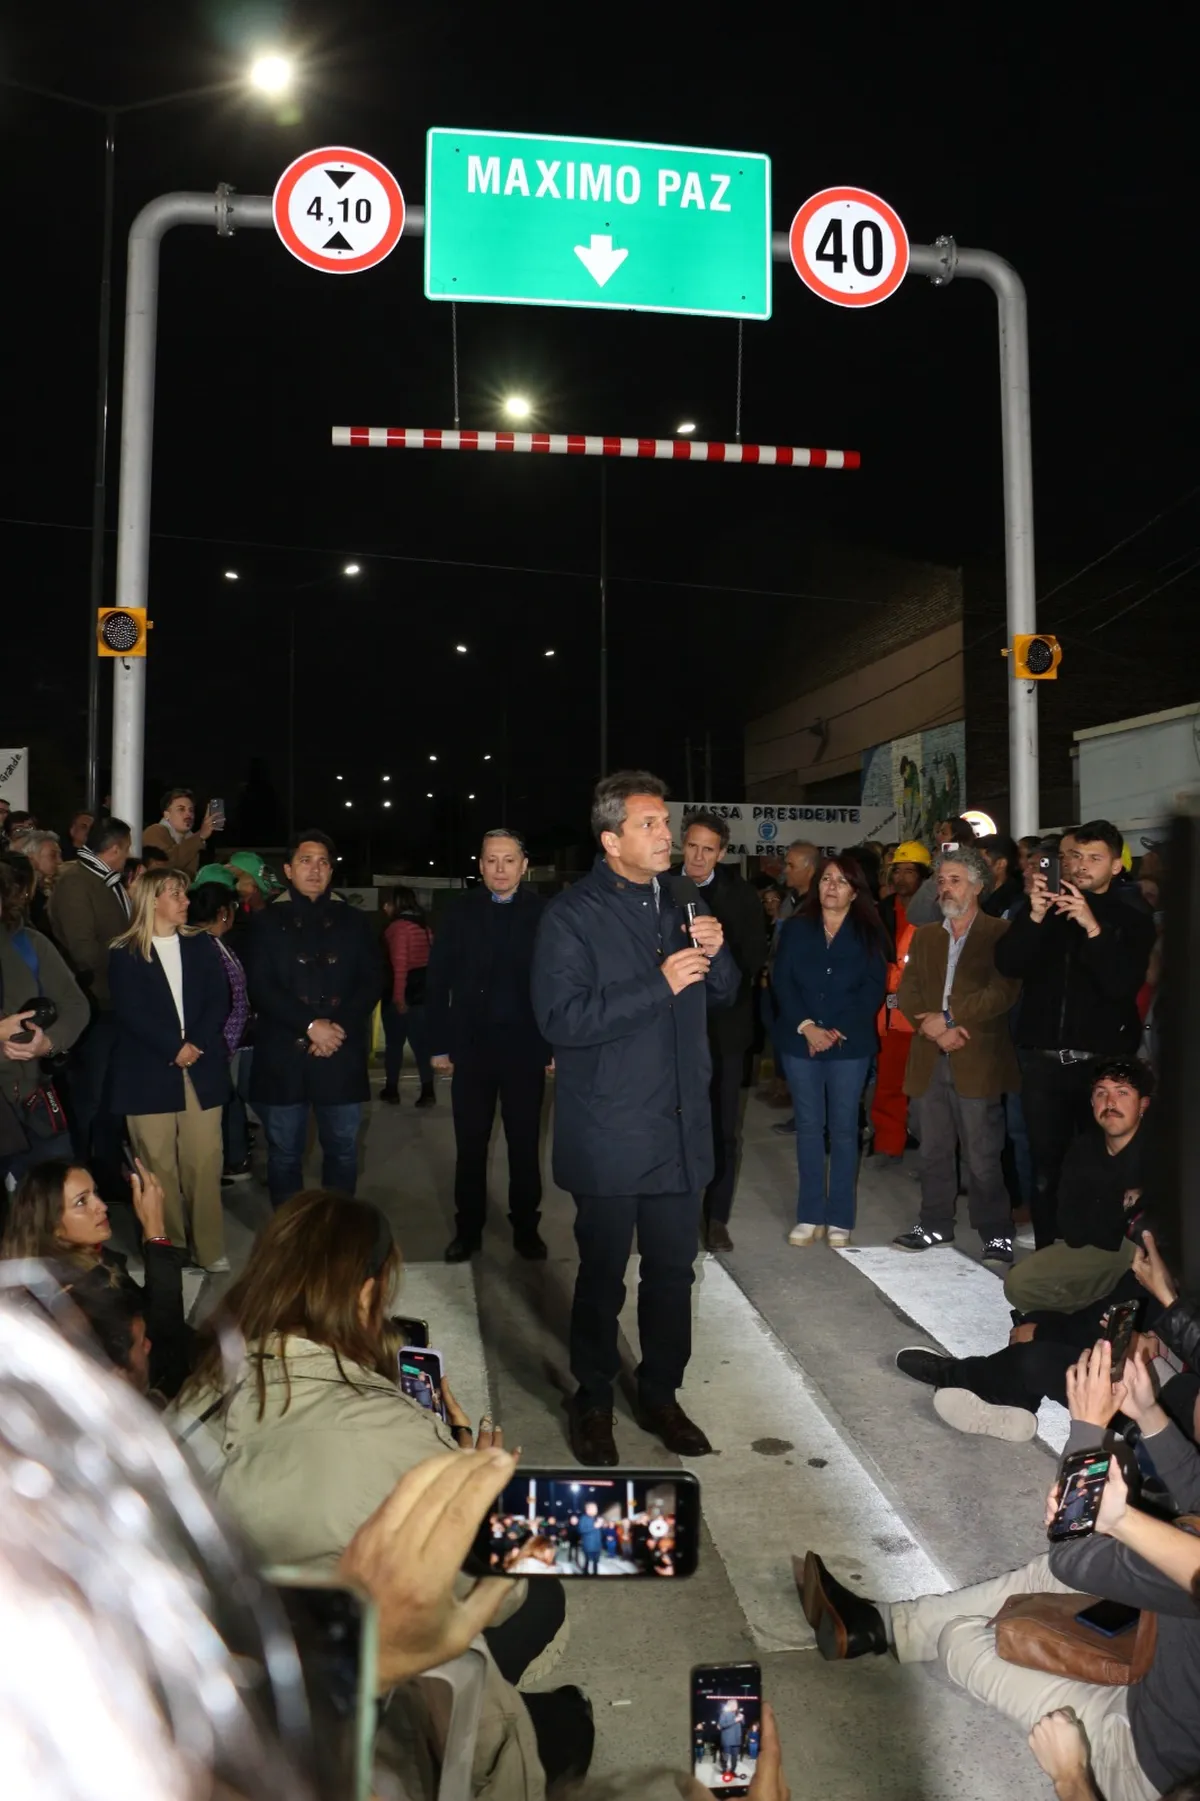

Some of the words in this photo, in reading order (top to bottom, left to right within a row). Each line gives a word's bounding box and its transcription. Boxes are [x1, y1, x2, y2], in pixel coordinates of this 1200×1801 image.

[467, 155, 641, 205] MAXIMO
[658, 169, 732, 212] PAZ
[307, 196, 372, 226] 4,10
[815, 218, 883, 277] 40
[753, 806, 860, 823] PRESIDENTE
